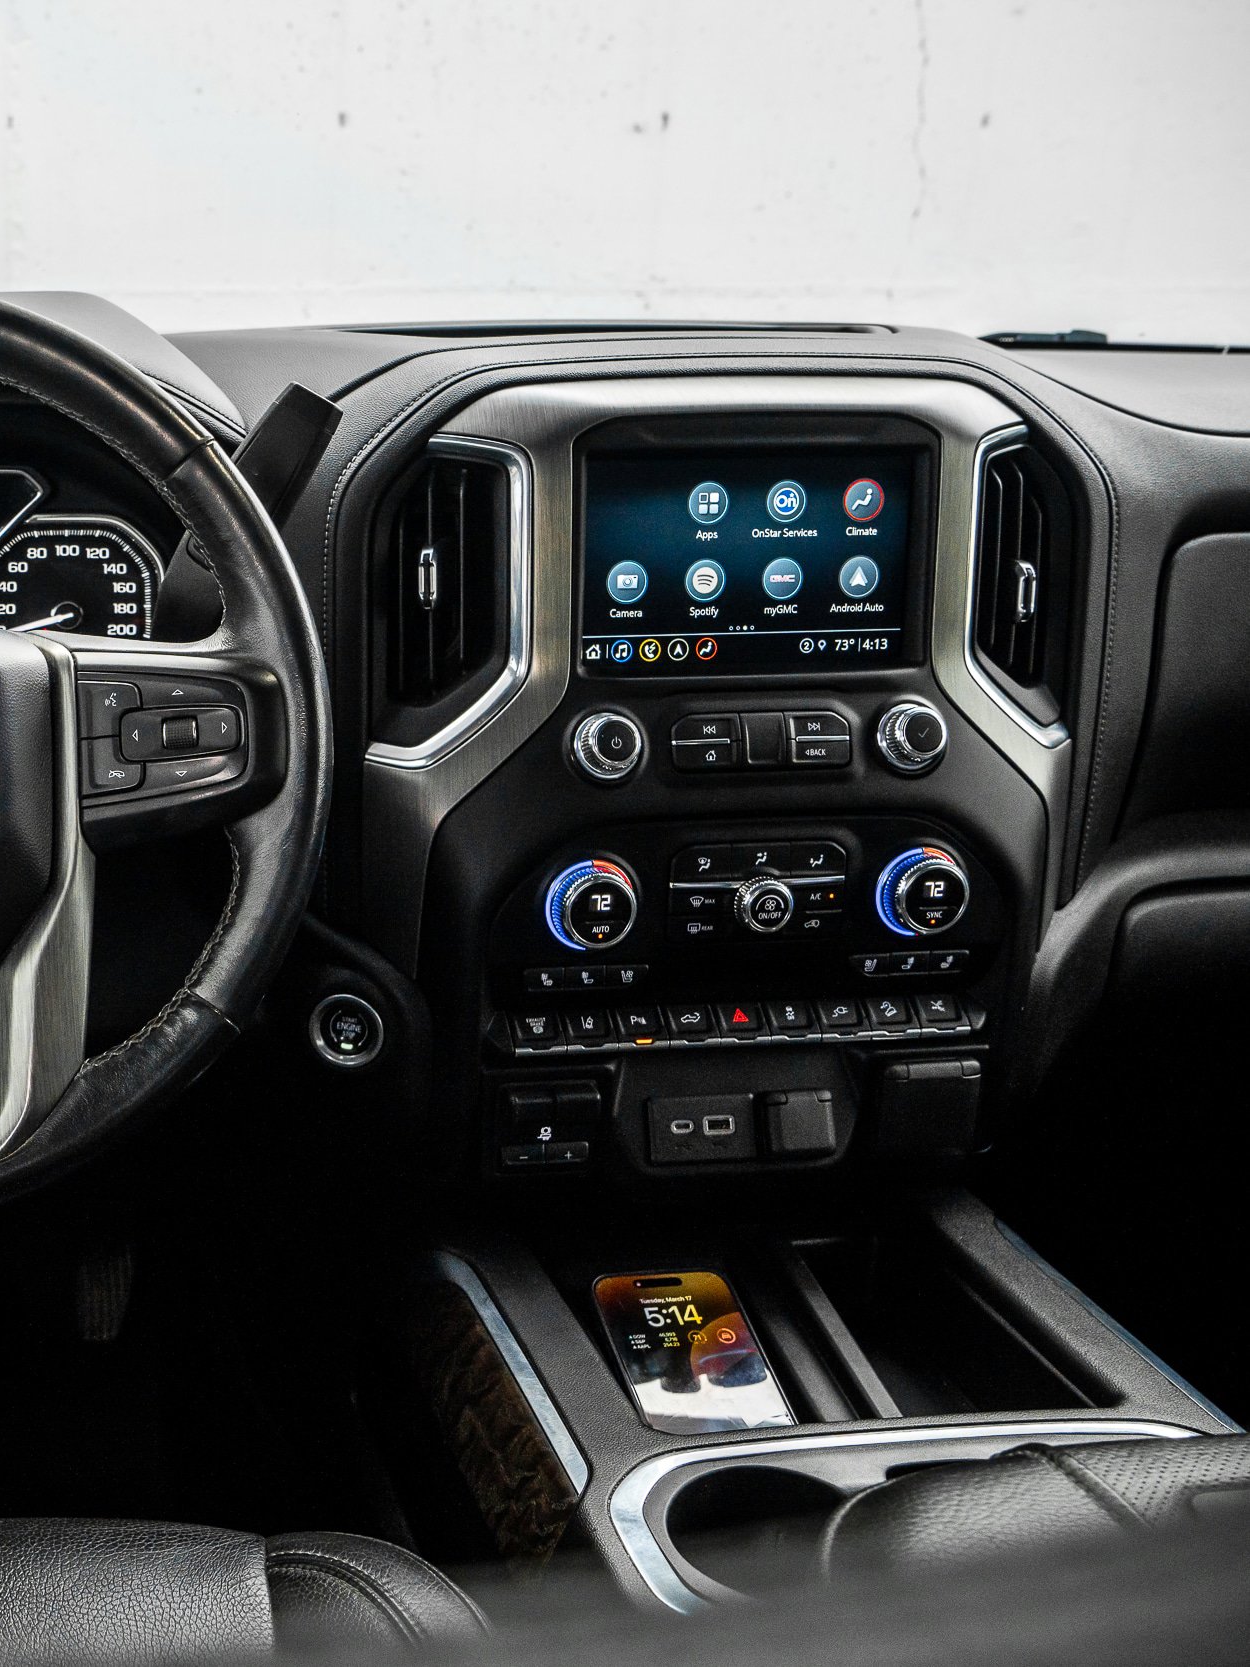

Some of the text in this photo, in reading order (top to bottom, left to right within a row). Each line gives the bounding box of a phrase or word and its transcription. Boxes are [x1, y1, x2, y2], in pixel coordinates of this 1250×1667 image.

[695, 529, 718, 541] Apps
[751, 528, 818, 538] OnStar Services
[845, 526, 878, 536] Climate
[26, 547, 47, 559] 80
[54, 544, 80, 557] 100
[85, 547, 109, 560] 120
[7, 561, 28, 573] 60
[102, 563, 127, 575] 140
[769, 574, 796, 583] GMC
[112, 582, 136, 594] 160
[113, 603, 137, 614] 180
[609, 608, 643, 618] Camera
[689, 606, 719, 618] Spotify
[764, 604, 798, 616] myGMC
[830, 602, 885, 613] Android Auto
[107, 624, 137, 636] 200
[834, 638, 855, 651] 73°
[862, 638, 888, 651] 4:13
[810, 748, 826, 756] BACK
[925, 881, 945, 897] 72
[591, 894, 611, 911] 72
[809, 892, 822, 901] A/C
[758, 912, 782, 920] ON/OFF
[926, 911, 943, 919] SYNC
[591, 925, 610, 934] AUTO
[336, 1021, 362, 1033] ENGINE
[643, 1304, 703, 1328] 5:14
